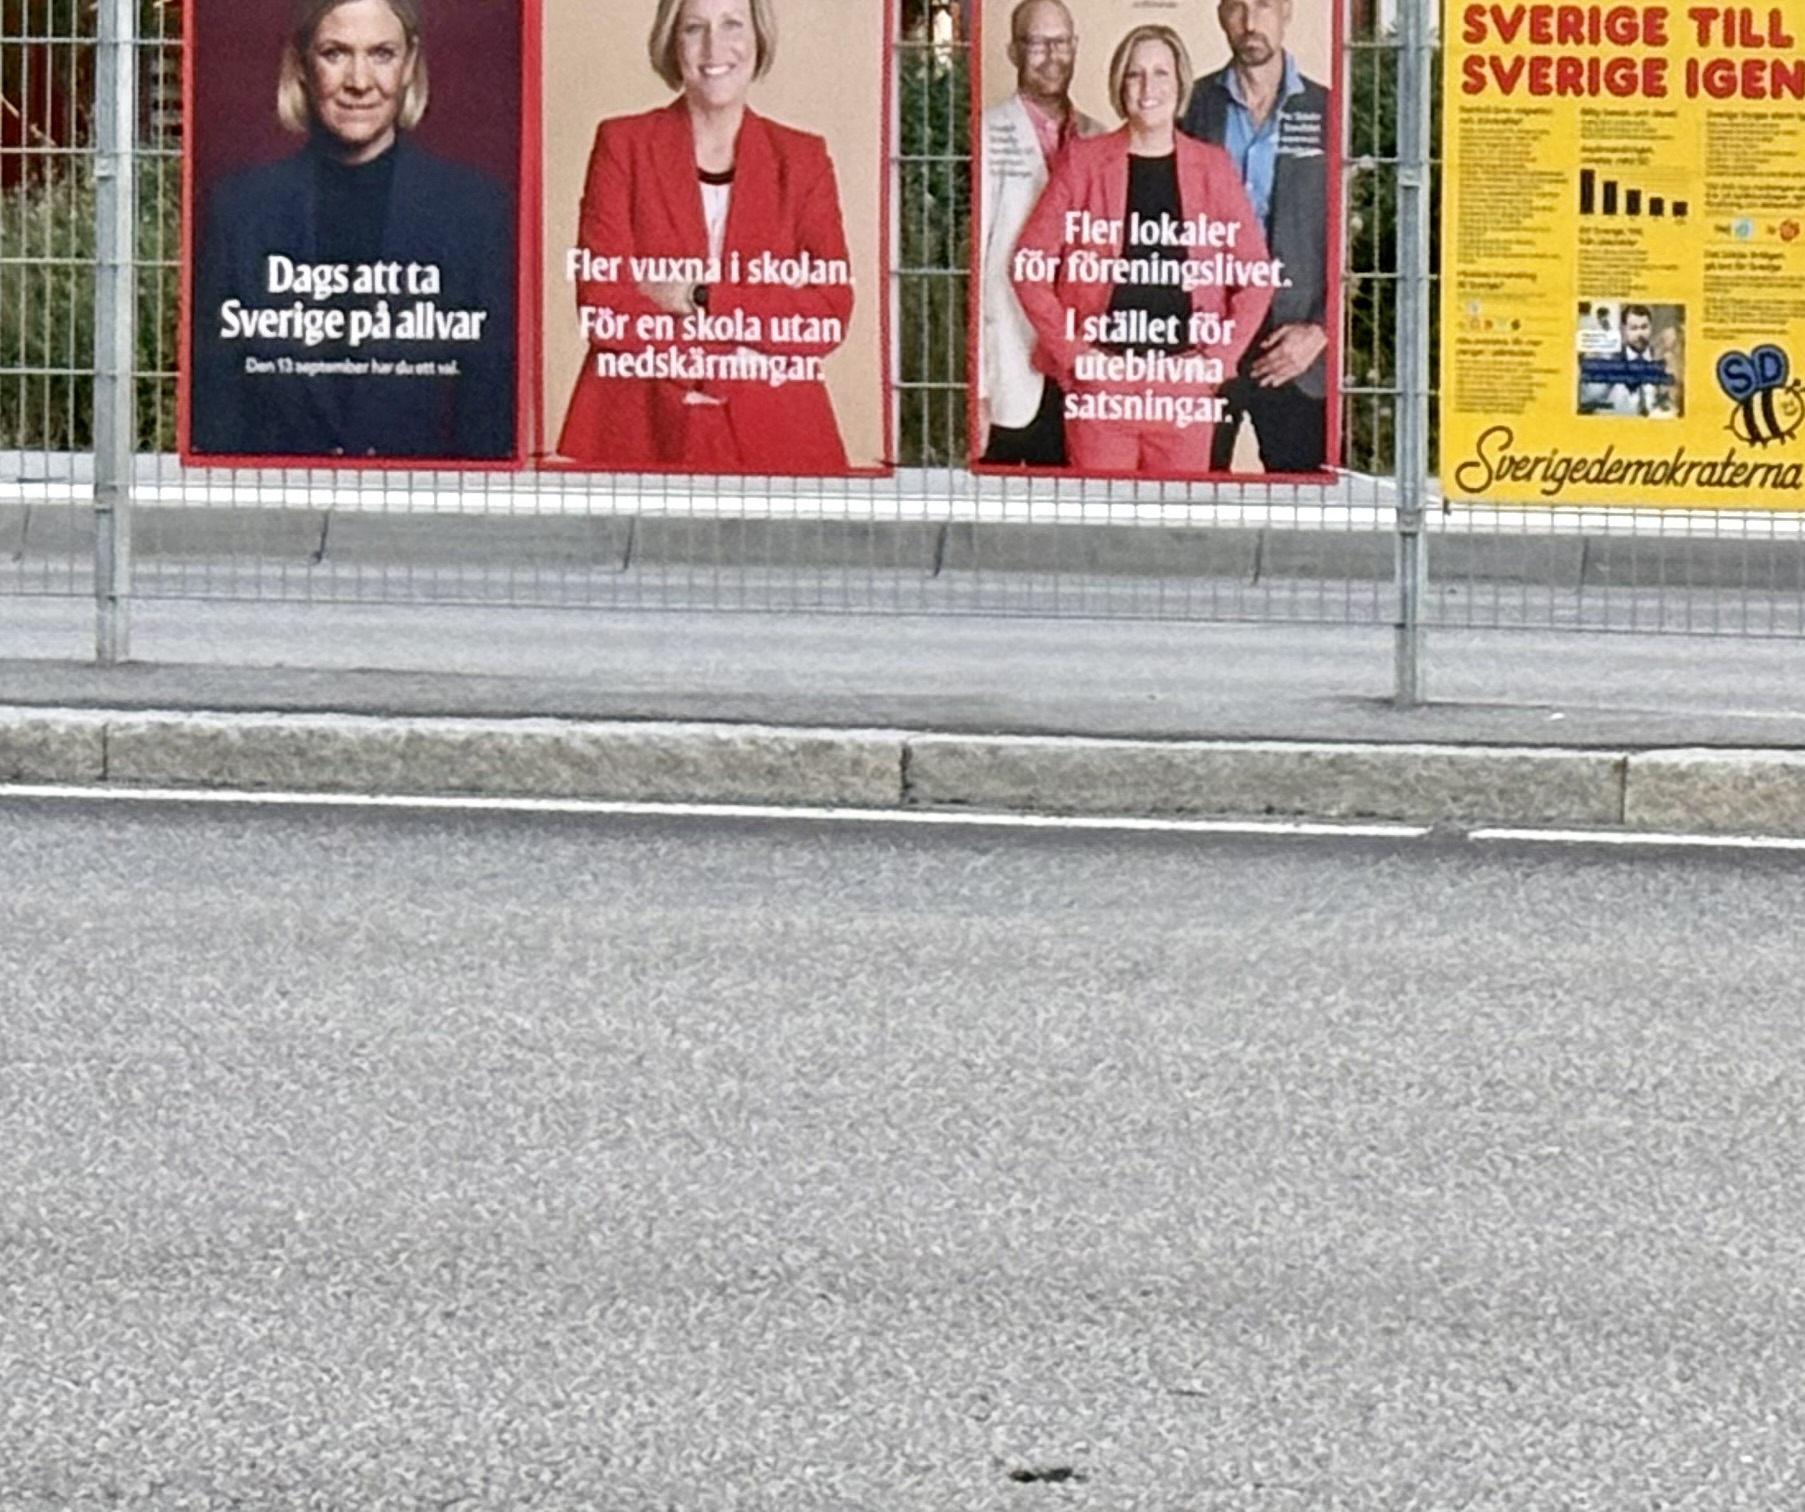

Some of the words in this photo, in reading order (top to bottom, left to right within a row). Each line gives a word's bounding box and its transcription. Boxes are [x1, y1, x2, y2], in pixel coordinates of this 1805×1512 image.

[1462, 4, 1669, 47] SVERIGE
[1687, 7, 1795, 48] TILL
[1461, 55, 1668, 99] SVERIGE
[1064, 211, 1121, 245] Fler
[1130, 212, 1241, 247] lokaler
[267, 254, 349, 300] Dags
[353, 260, 402, 294] att
[406, 262, 441, 294] ta
[565, 248, 622, 282] Fler
[629, 256, 722, 283] vuxna
[730, 251, 740, 283] i
[747, 251, 856, 285] skolan.
[1014, 249, 1060, 282] för
[1067, 252, 1293, 291] föreningslivet.
[220, 299, 345, 346] Sverige
[349, 300, 392, 346] på
[395, 301, 486, 339] allvar
[579, 306, 630, 338] För
[636, 314, 674, 339] en
[682, 307, 761, 341] skola
[770, 316, 842, 342] utan
[1065, 308, 1075, 340] I
[1083, 310, 1181, 344] stället
[1188, 312, 1236, 345] för
[597, 346, 826, 387] nedskärningar.
[1074, 349, 1224, 383] uteblivna
[1723, 351, 1784, 394] SD
[1063, 390, 1233, 428] satsningar.
[1454, 426, 1805, 496] Sverigedemokraterna
